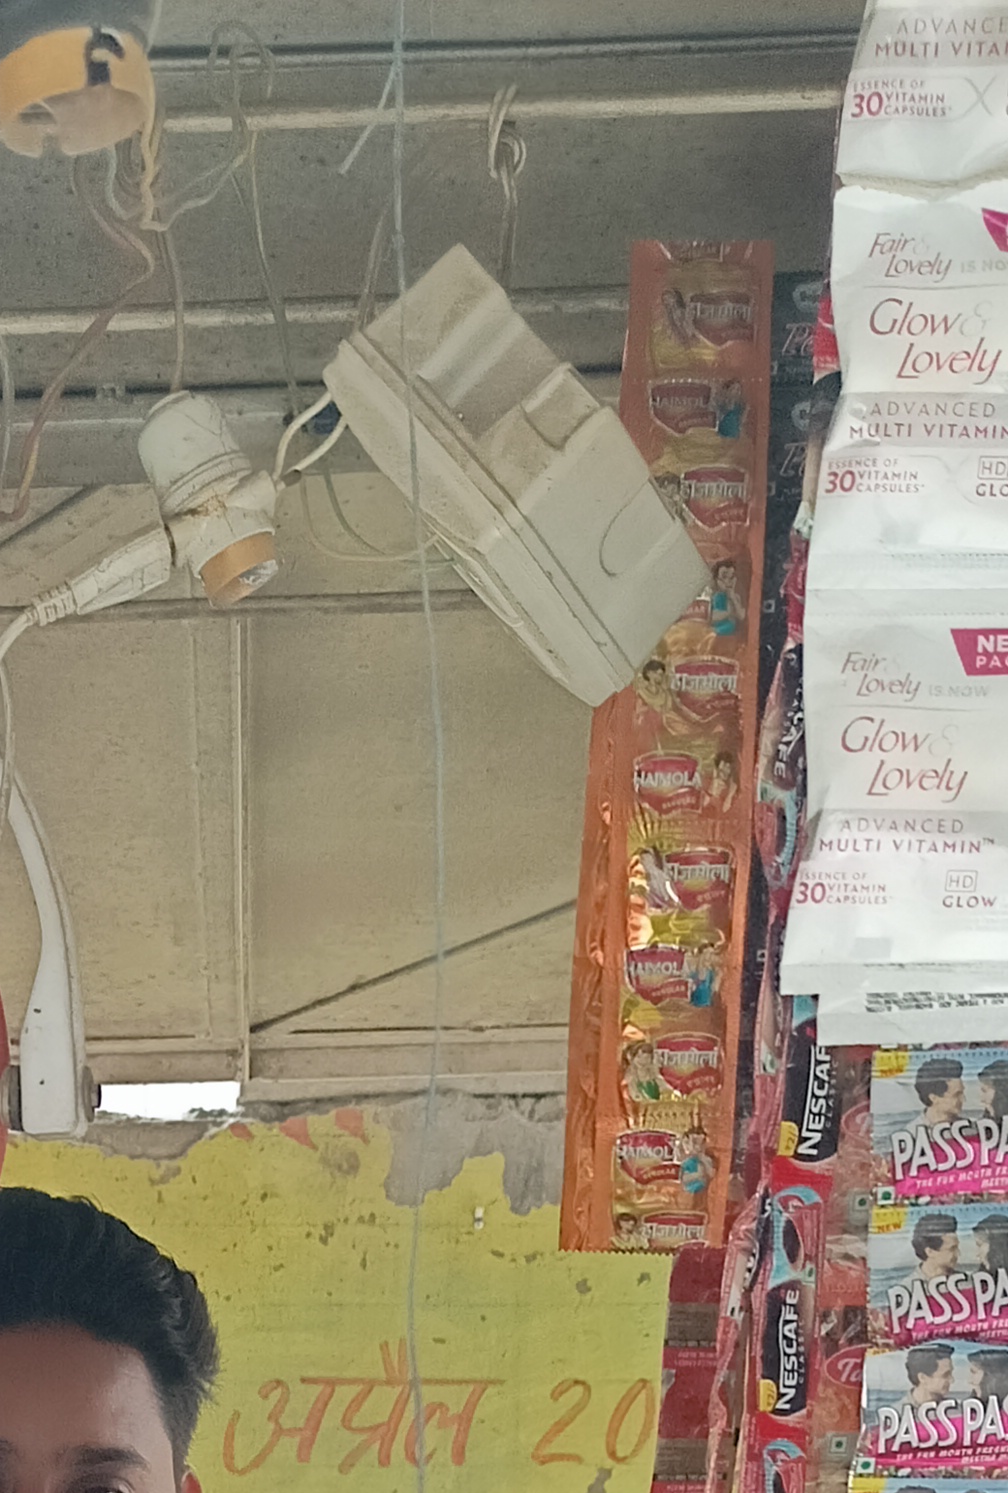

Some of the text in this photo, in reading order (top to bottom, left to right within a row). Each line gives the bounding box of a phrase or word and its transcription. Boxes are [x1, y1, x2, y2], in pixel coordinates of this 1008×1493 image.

[897, 17, 1008, 35] ADVANCE
[875, 41, 1008, 58] MULTI VITA
[853, 78, 905, 92] ESSENCE
[851, 91, 883, 118] 30
[884, 92, 945, 104] VITAMIN
[869, 233, 913, 258] Fair
[885, 252, 952, 281] Lovely
[869, 299, 961, 337] Glow
[897, 338, 1002, 385] Lovely
[870, 401, 996, 418] ADVANCED
[850, 423, 912, 439] MULTI
[828, 458, 898, 470] ESSENCE OF
[982, 461, 1006, 476] HD
[825, 470, 856, 493] 30
[858, 470, 918, 481] VITAMIN
[976, 483, 1008, 497] GLO
[977, 634, 1008, 653] NE
[841, 652, 886, 674] Fair
[856, 673, 989, 702] Lovely NOW
[842, 716, 929, 753] Glow
[866, 759, 968, 803] Lovely
[842, 818, 964, 834] ADVANCED
[820, 838, 881, 853] MULTI
[827, 882, 886, 893] VITAMIN
[948, 874, 974, 889] HD
[796, 882, 826, 904] 30
[942, 895, 997, 908] GLOW
[798, 1044, 831, 1155] NESCAF
[892, 1119, 974, 1180] PASS
[888, 1272, 971, 1334] PASS
[223, 1337, 506, 1476] अप्रैल
[877, 1399, 957, 1454] PASS
